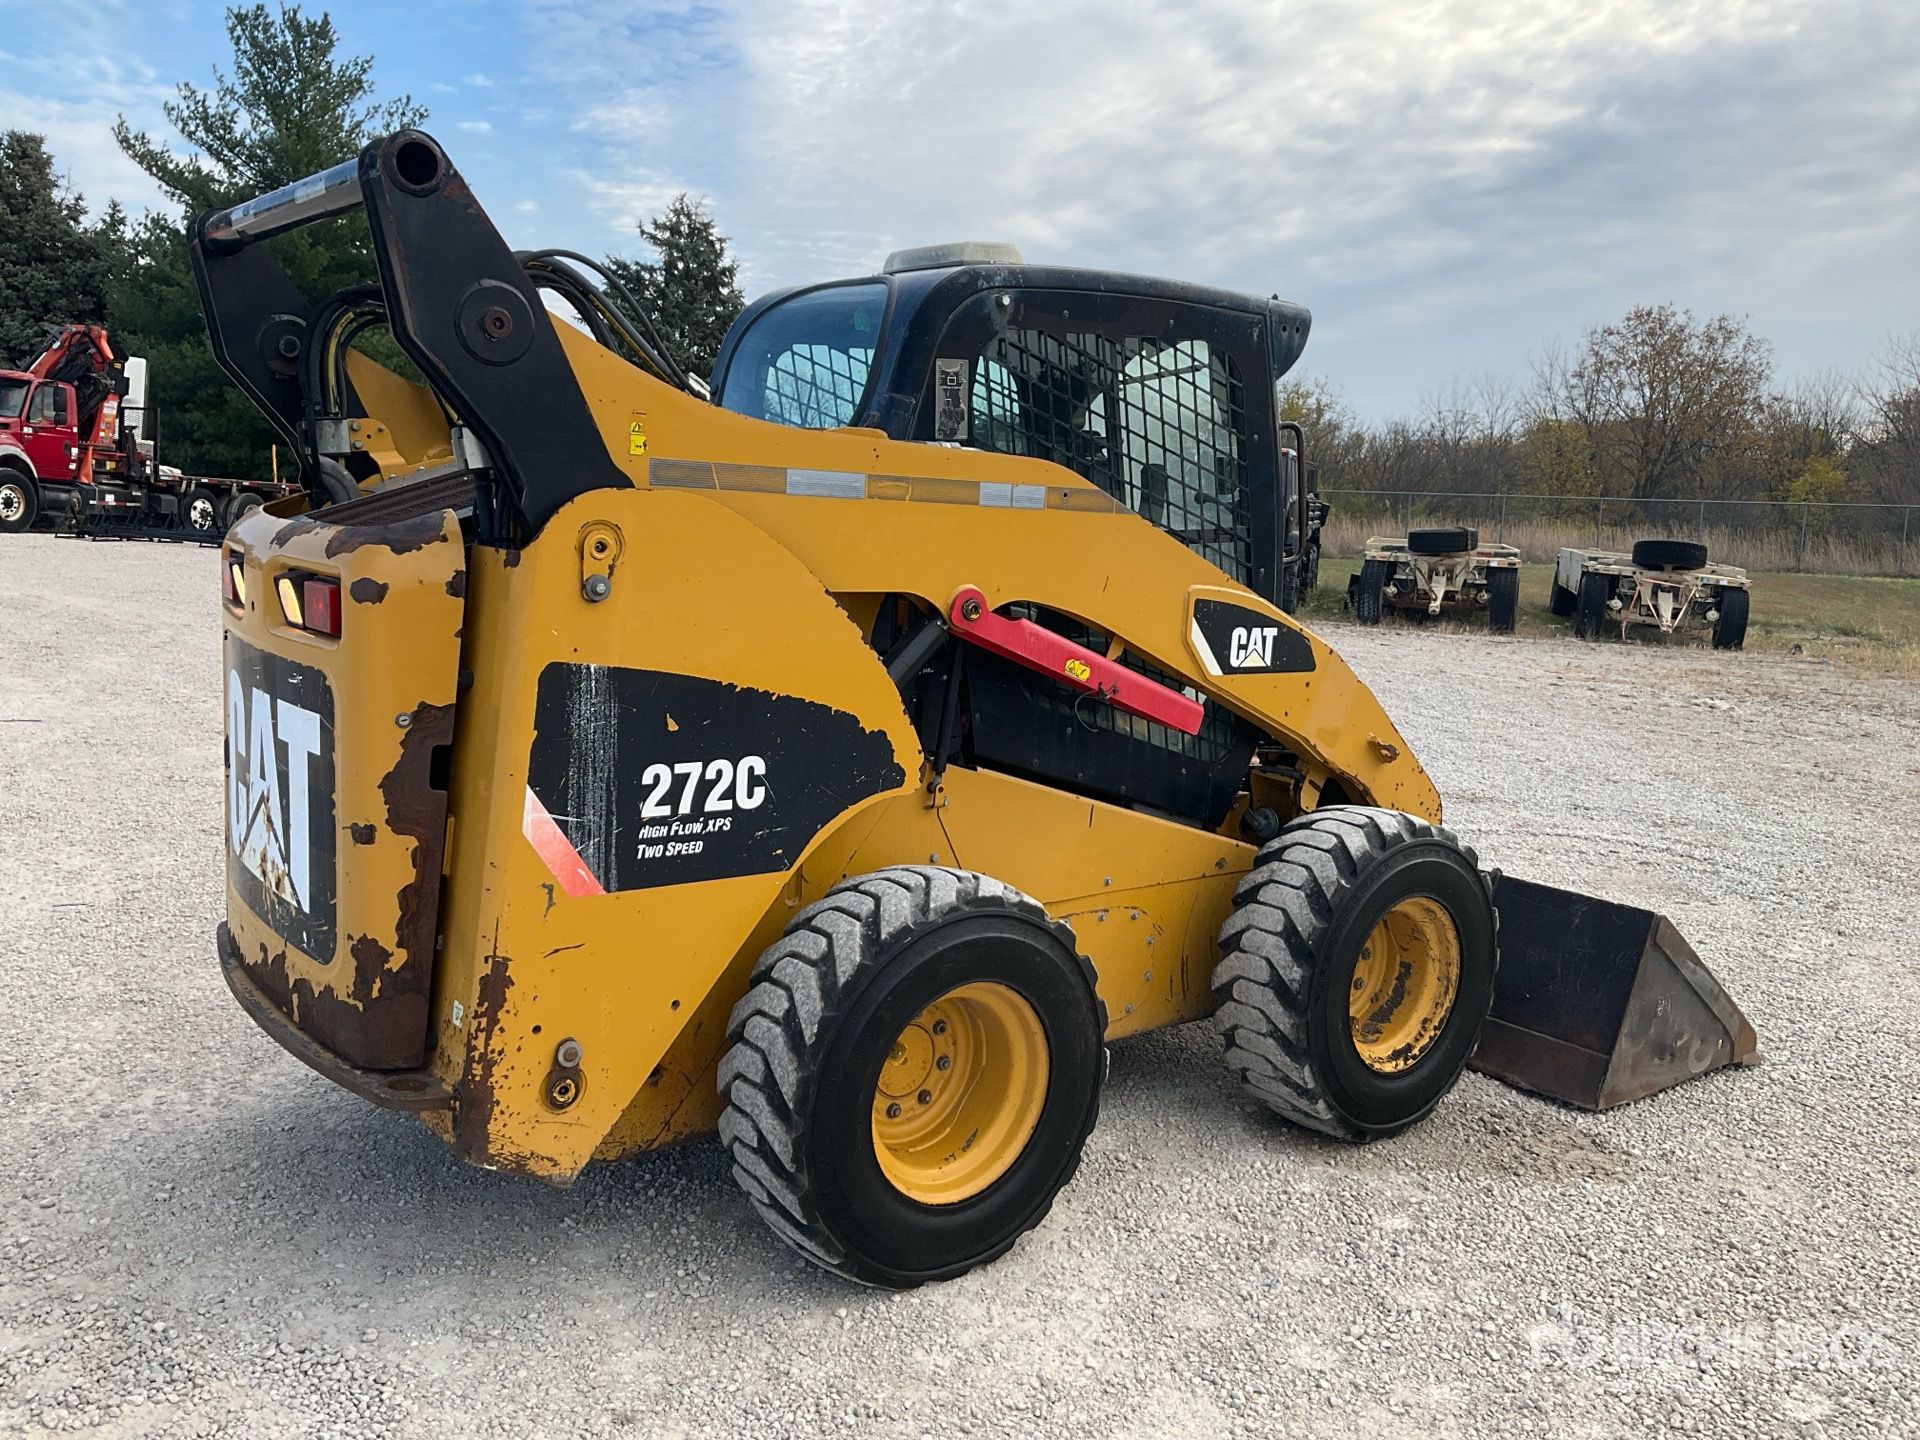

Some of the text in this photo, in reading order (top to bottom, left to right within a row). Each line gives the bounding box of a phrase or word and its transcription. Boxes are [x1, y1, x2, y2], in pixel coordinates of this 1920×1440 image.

[1229, 627, 1278, 667] CAT
[229, 669, 320, 914] CAT
[641, 755, 767, 818] 272C
